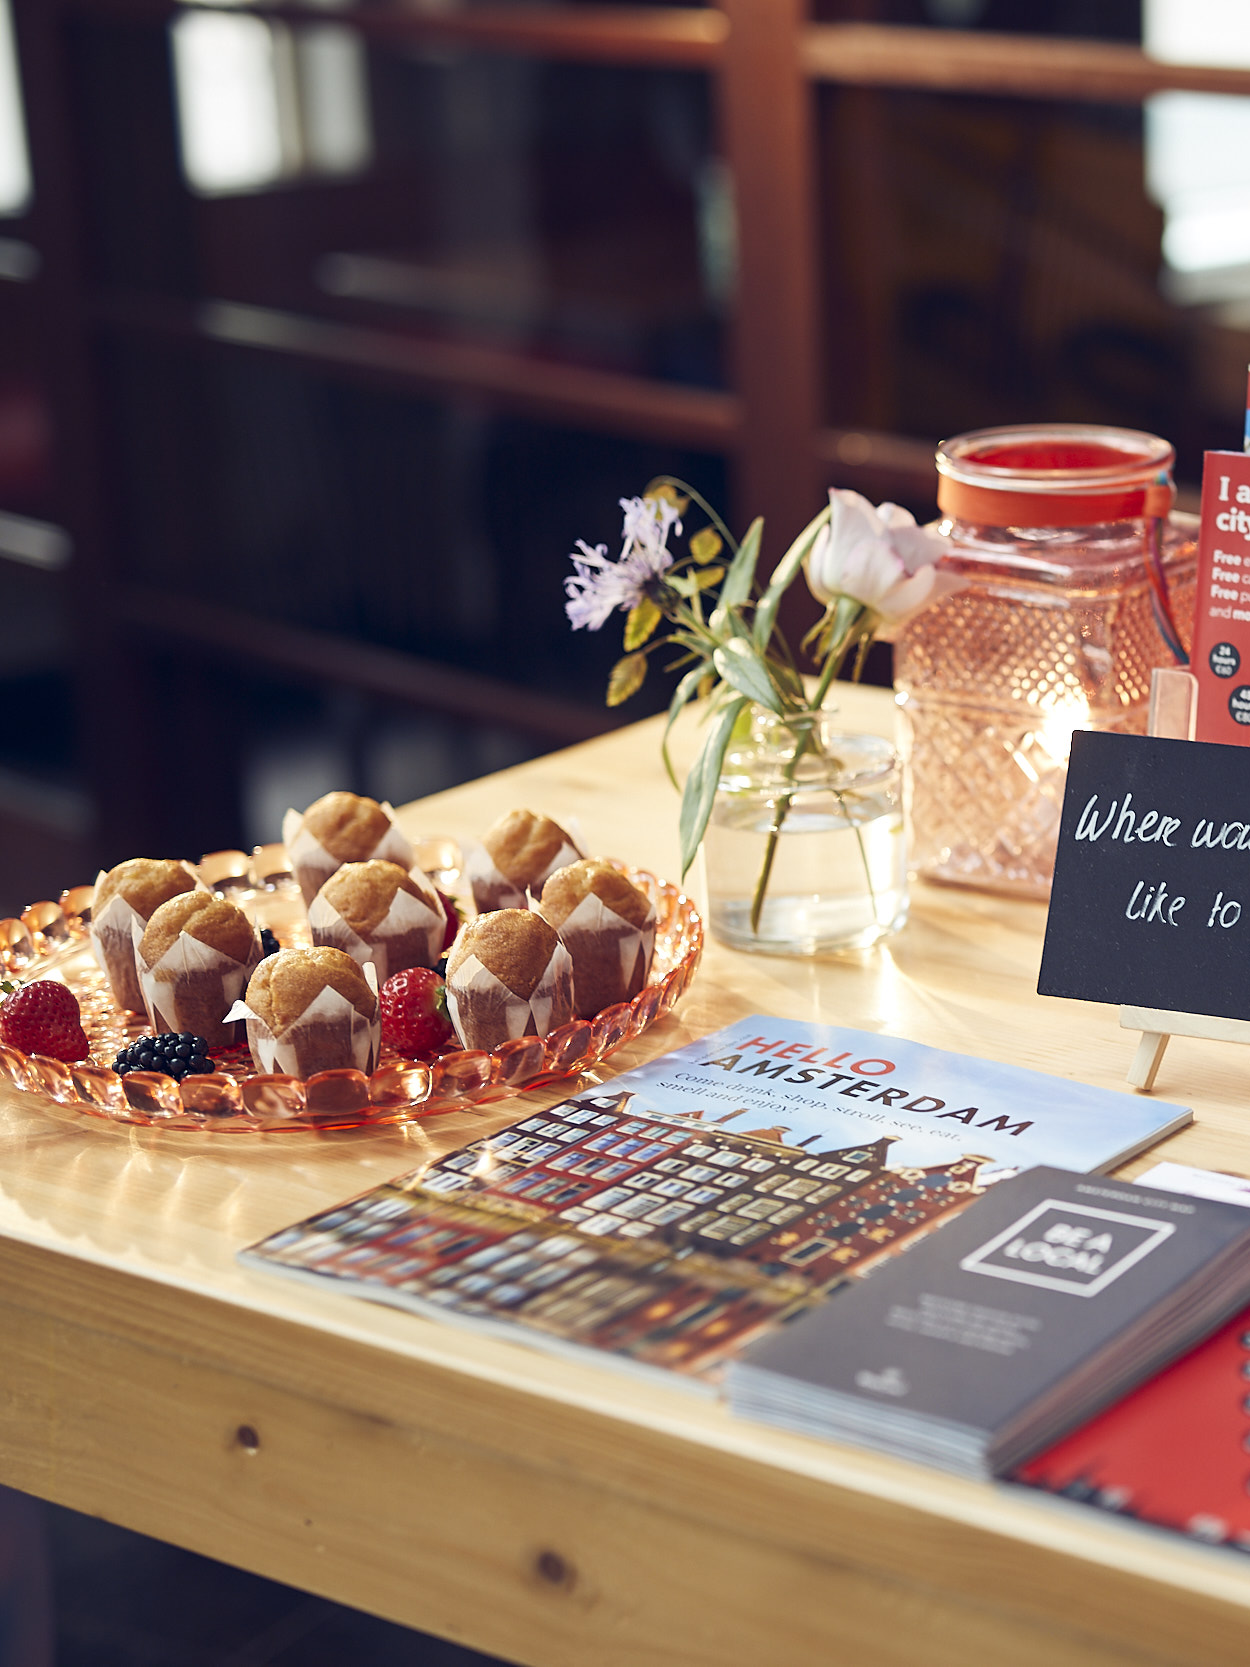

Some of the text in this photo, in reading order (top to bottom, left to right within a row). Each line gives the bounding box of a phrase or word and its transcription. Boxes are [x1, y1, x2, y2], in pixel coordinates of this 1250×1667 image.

[1218, 476, 1230, 501] I
[1213, 549, 1242, 566] Free
[1211, 567, 1240, 583] Free
[1210, 584, 1239, 600] Free
[1209, 605, 1231, 619] and
[1075, 793, 1182, 848] Where
[1206, 891, 1243, 929] to
[735, 1035, 896, 1077] HELLO
[674, 1072, 725, 1088] Come
[656, 1079, 801, 1115] smell and enjoy!
[698, 1054, 1036, 1137] AMSTERDAM
